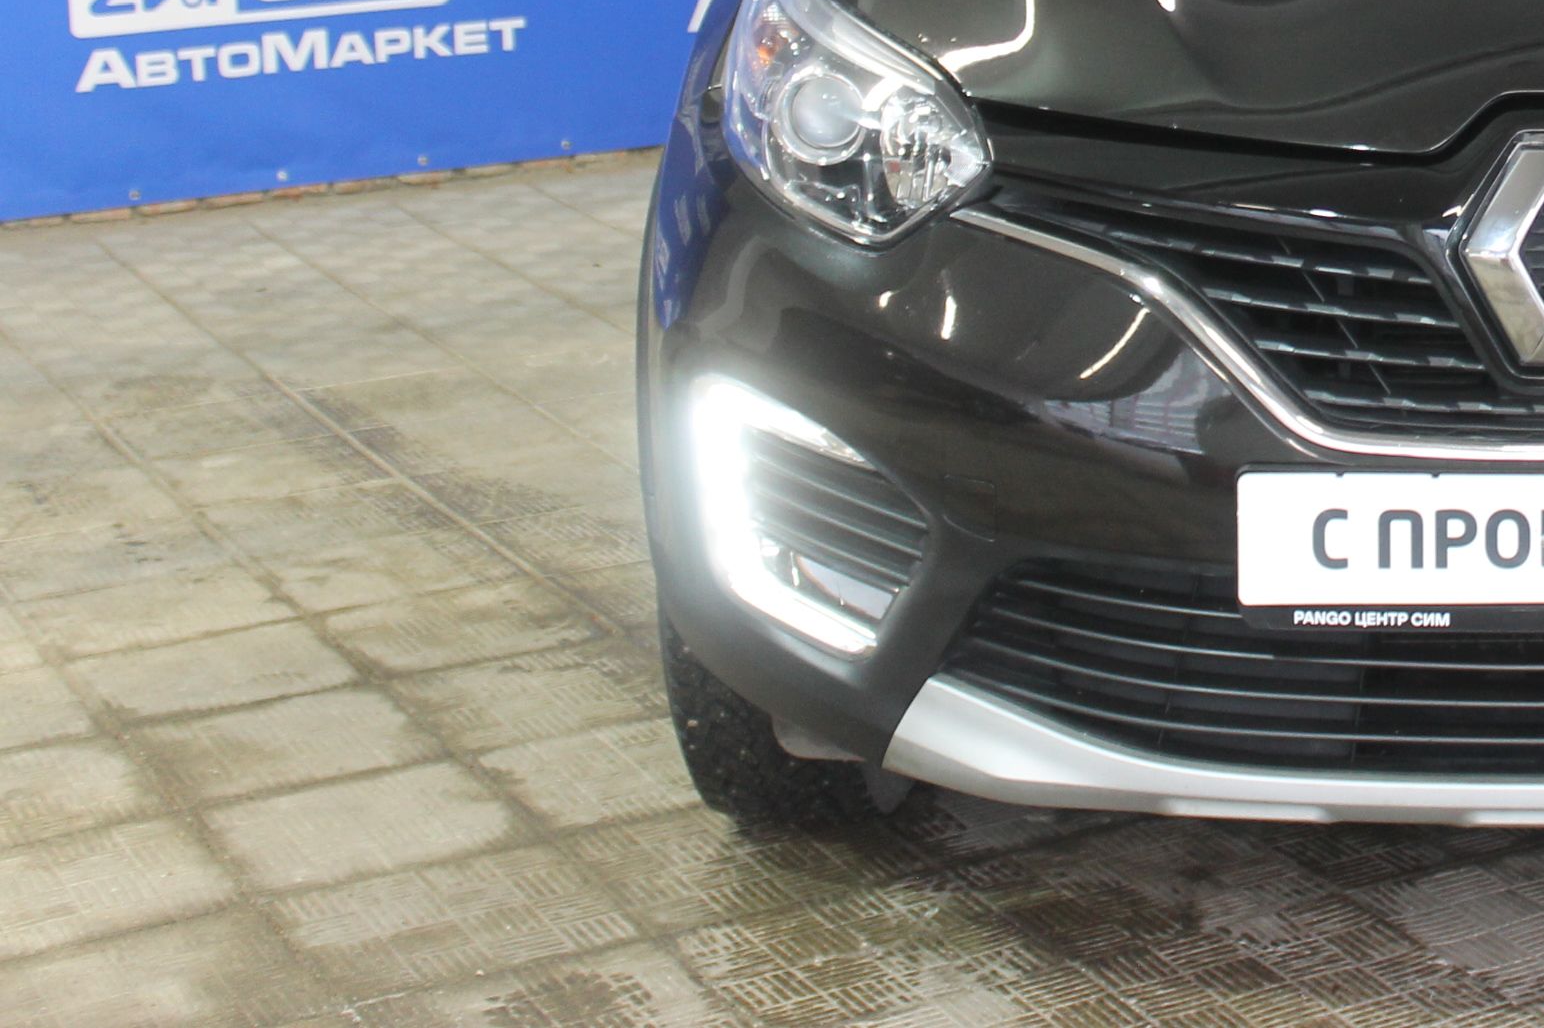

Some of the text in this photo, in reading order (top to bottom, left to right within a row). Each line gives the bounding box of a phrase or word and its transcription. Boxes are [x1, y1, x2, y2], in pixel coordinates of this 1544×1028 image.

[1312, 508, 1349, 569] С
[1293, 610, 1450, 628] PANGO ЦЕНТР СИМ
